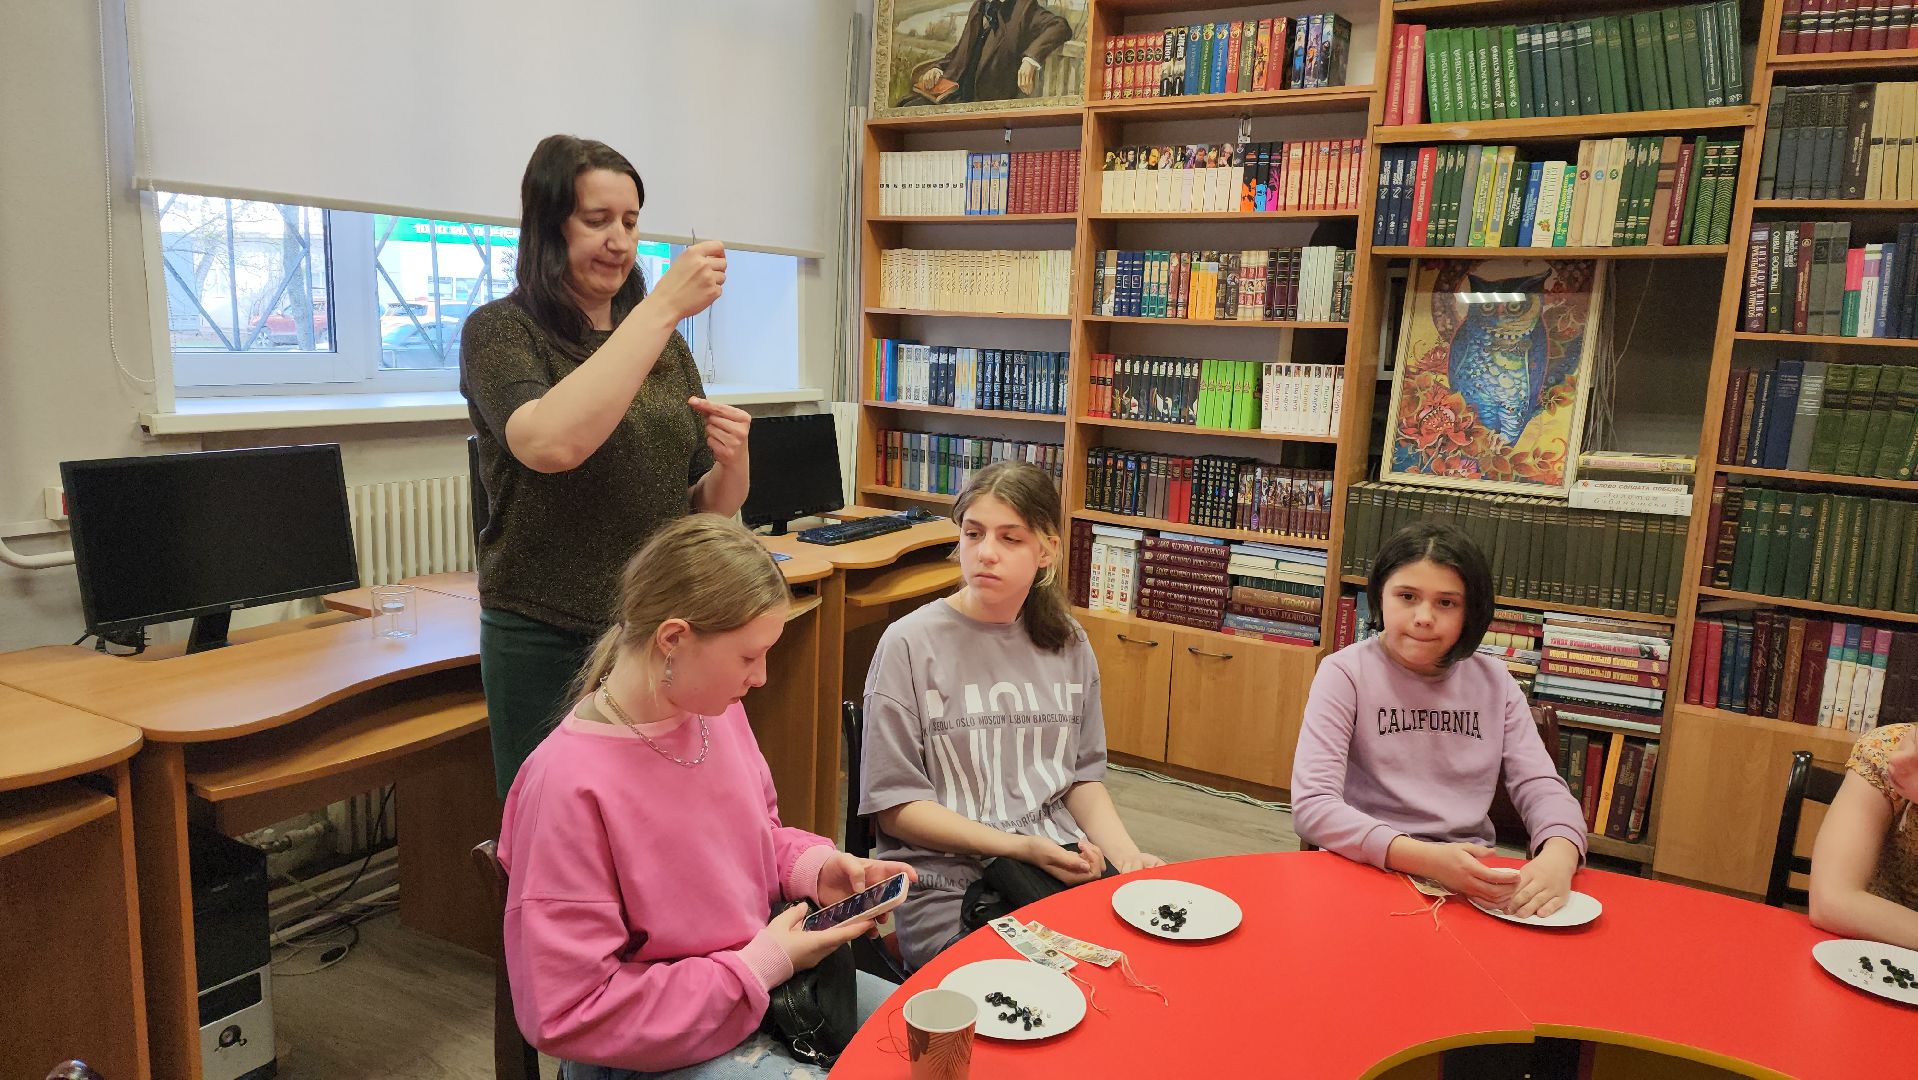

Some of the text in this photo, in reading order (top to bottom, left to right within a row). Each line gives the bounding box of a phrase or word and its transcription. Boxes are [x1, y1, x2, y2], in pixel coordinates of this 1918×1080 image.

[933, 721, 954, 731] SEOUL
[956, 718, 975, 727] OSLO
[979, 715, 1006, 725] MOSCOW
[1377, 707, 1483, 740] CALIFORNIA
